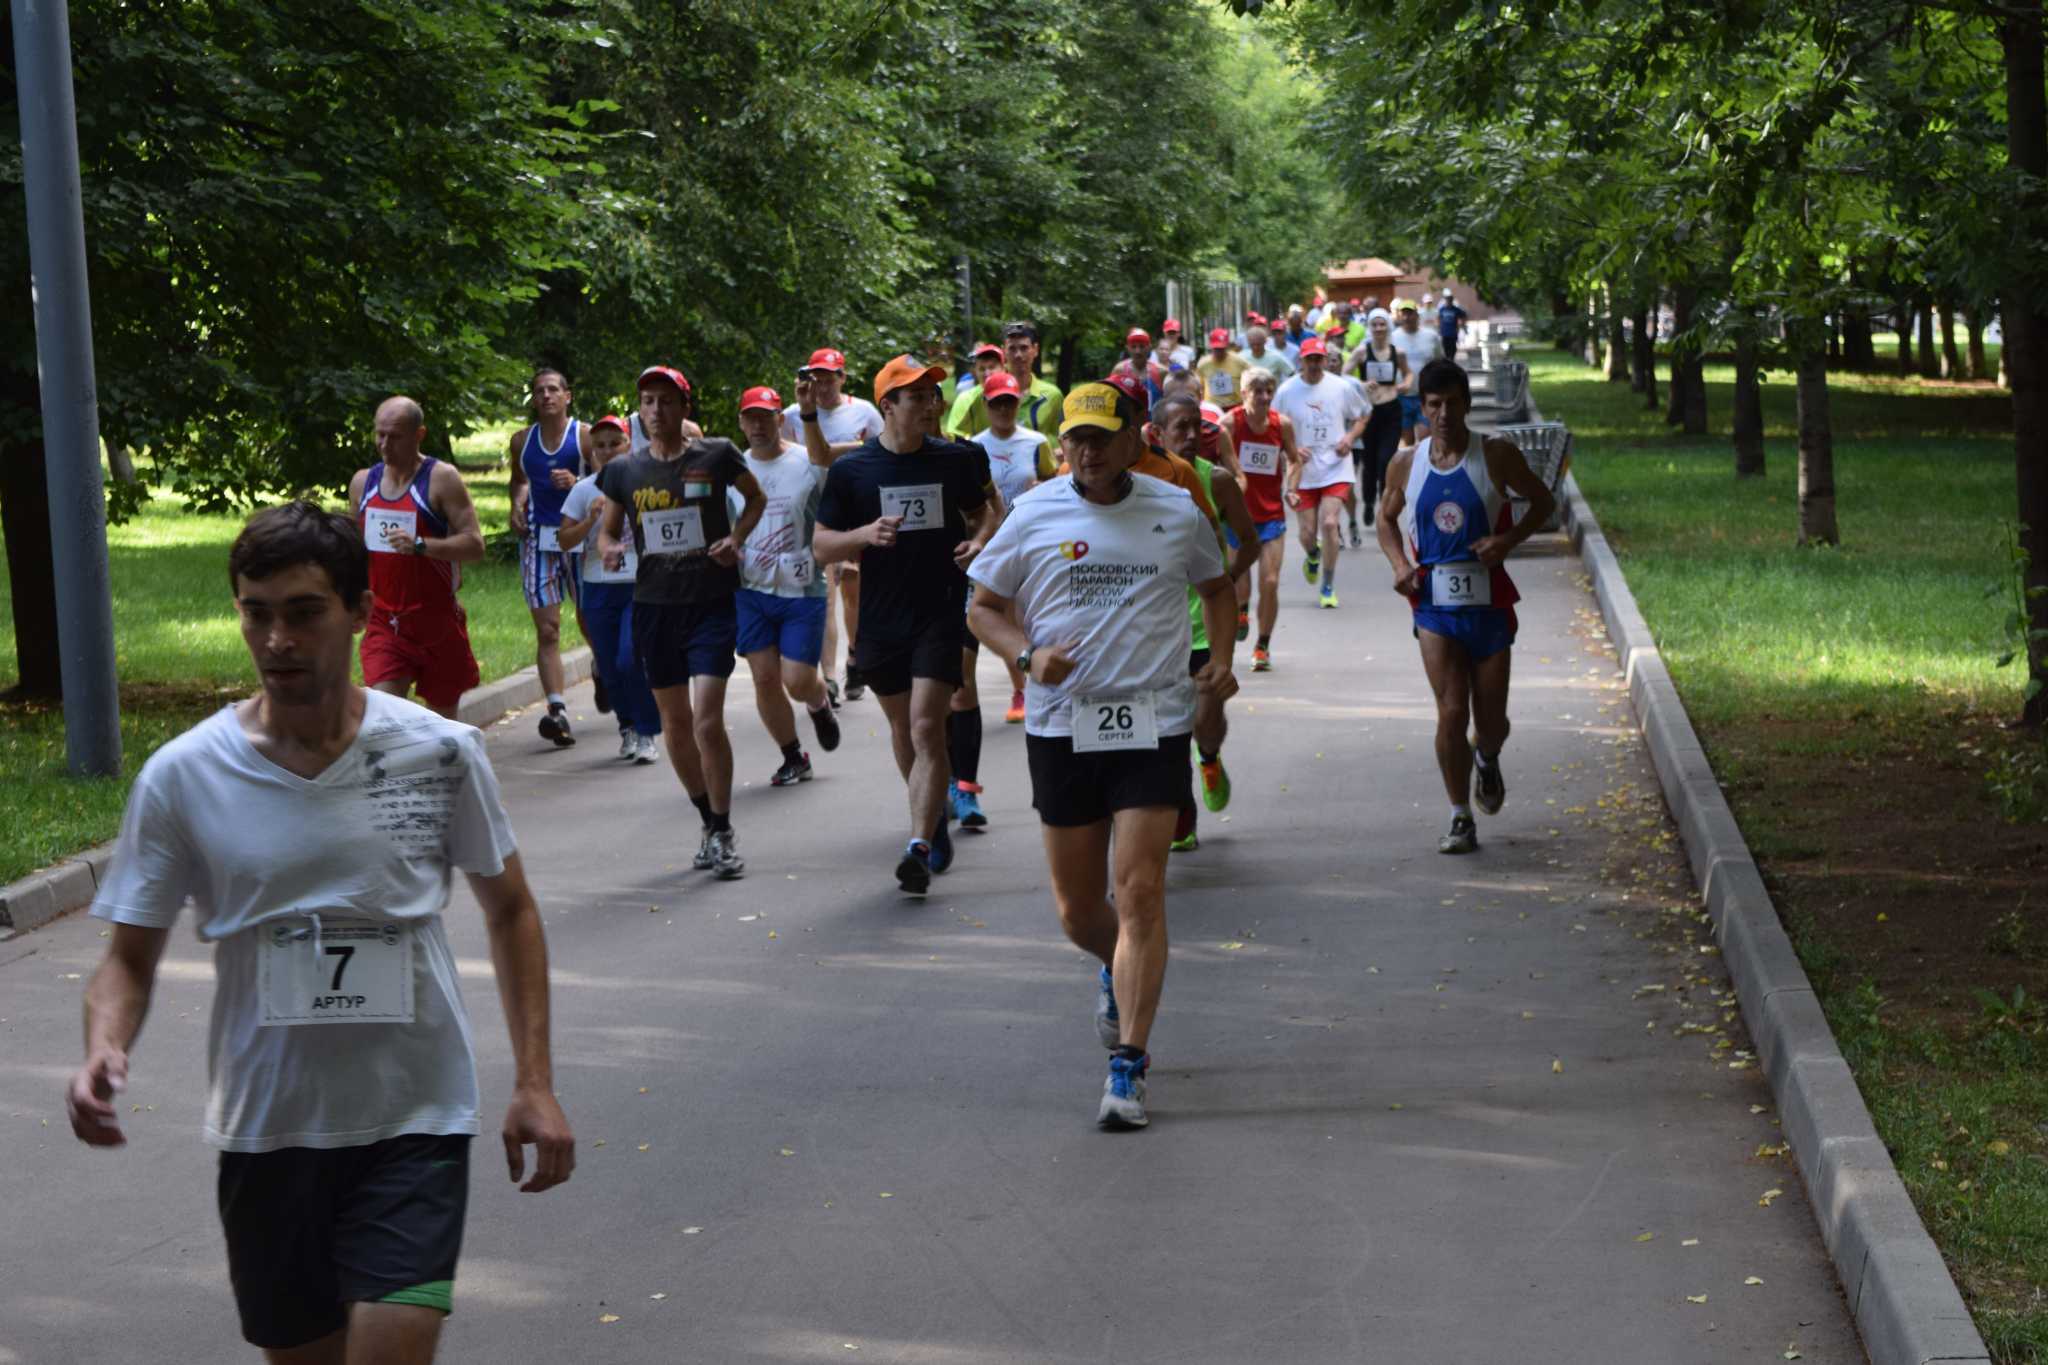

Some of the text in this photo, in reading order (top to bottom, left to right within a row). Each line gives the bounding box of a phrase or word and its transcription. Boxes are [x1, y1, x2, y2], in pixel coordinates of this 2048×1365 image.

[1251, 452, 1268, 465] 60
[900, 499, 925, 518] 73
[661, 521, 684, 540] 67
[1070, 562, 1159, 576] МОСКОВСКИЙ
[1070, 575, 1133, 586] МАРАФОН
[1449, 575, 1471, 593] 31
[1098, 705, 1133, 730] 26
[1098, 731, 1134, 741] СЕРГЕЙ
[325, 946, 355, 990] 7
[312, 995, 366, 1009] АРТУР
